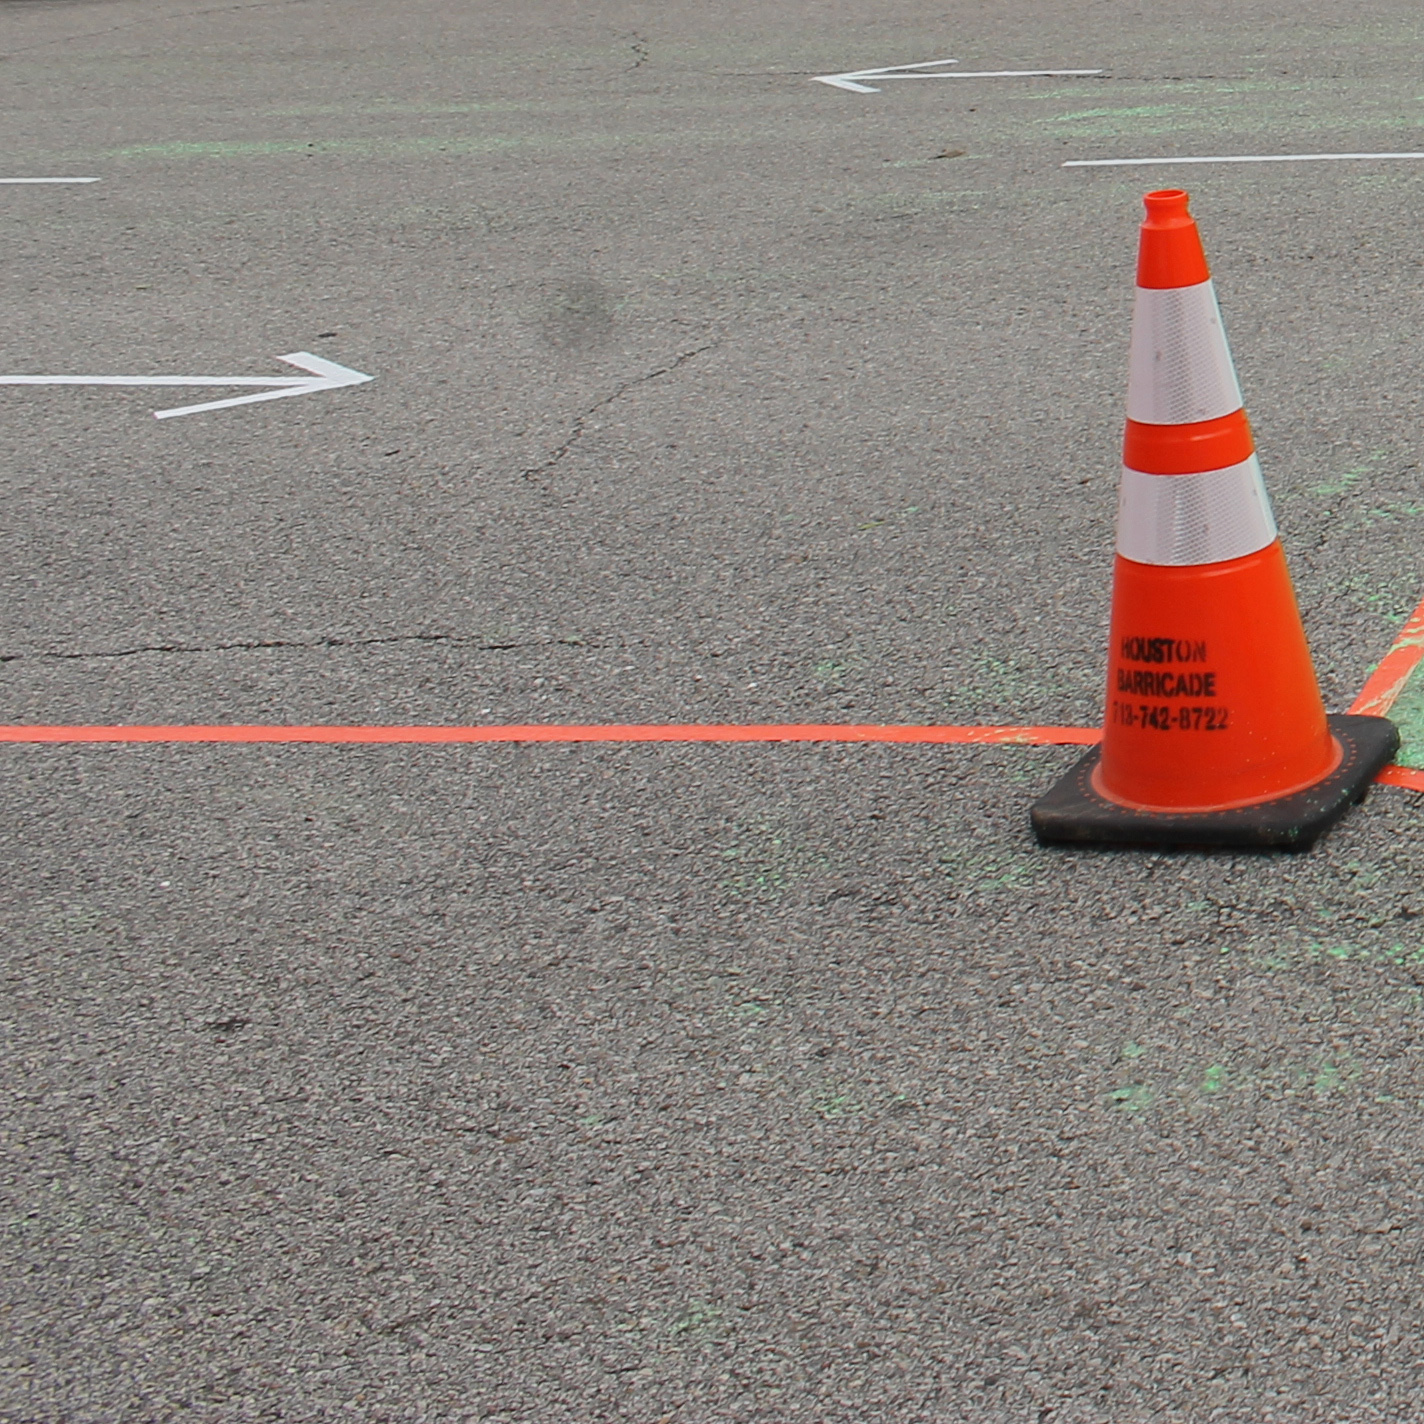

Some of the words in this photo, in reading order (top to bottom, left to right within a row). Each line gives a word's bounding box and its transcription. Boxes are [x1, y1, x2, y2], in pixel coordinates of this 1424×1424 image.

[1121, 637, 1206, 664] HOUSTON
[1117, 669, 1216, 697] BARRICADE
[1113, 701, 1229, 730] 713-742-8722
